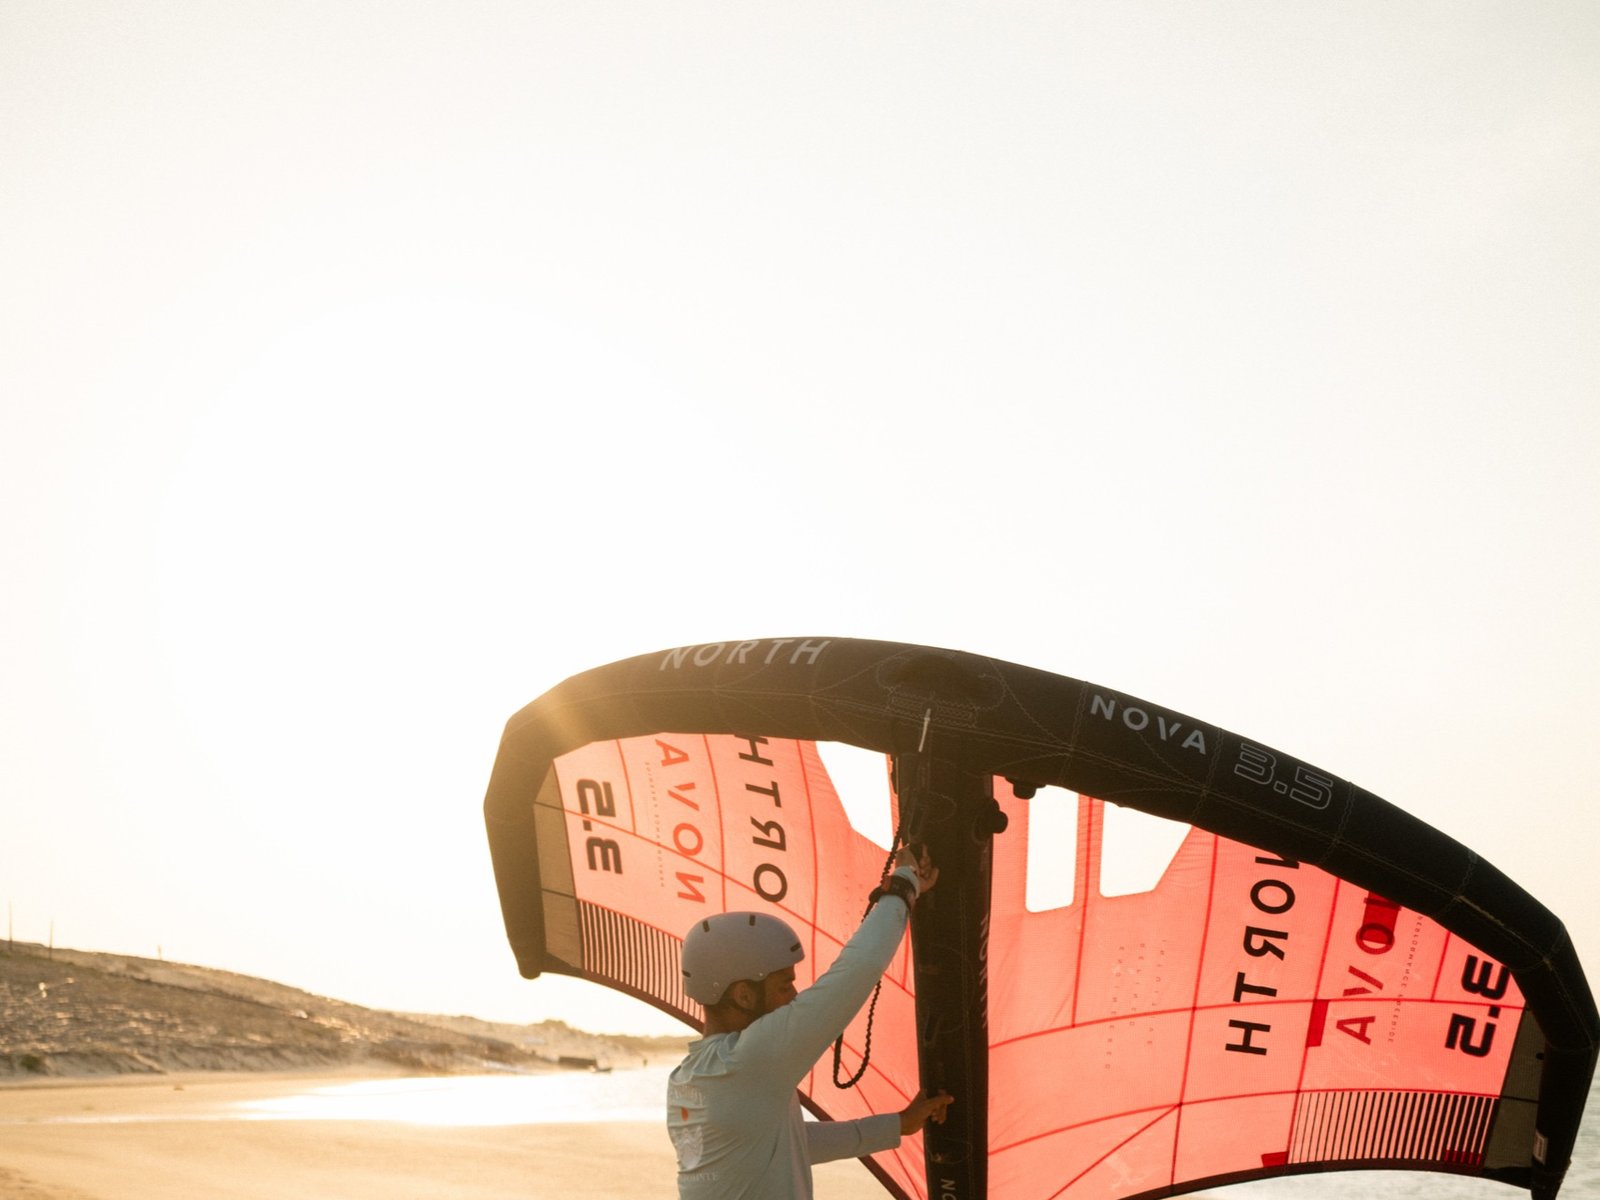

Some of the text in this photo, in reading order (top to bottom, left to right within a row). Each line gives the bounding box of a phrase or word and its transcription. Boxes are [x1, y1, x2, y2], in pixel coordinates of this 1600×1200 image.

[659, 639, 832, 671] NORTH
[1090, 694, 1334, 810] NOVA 3.5
